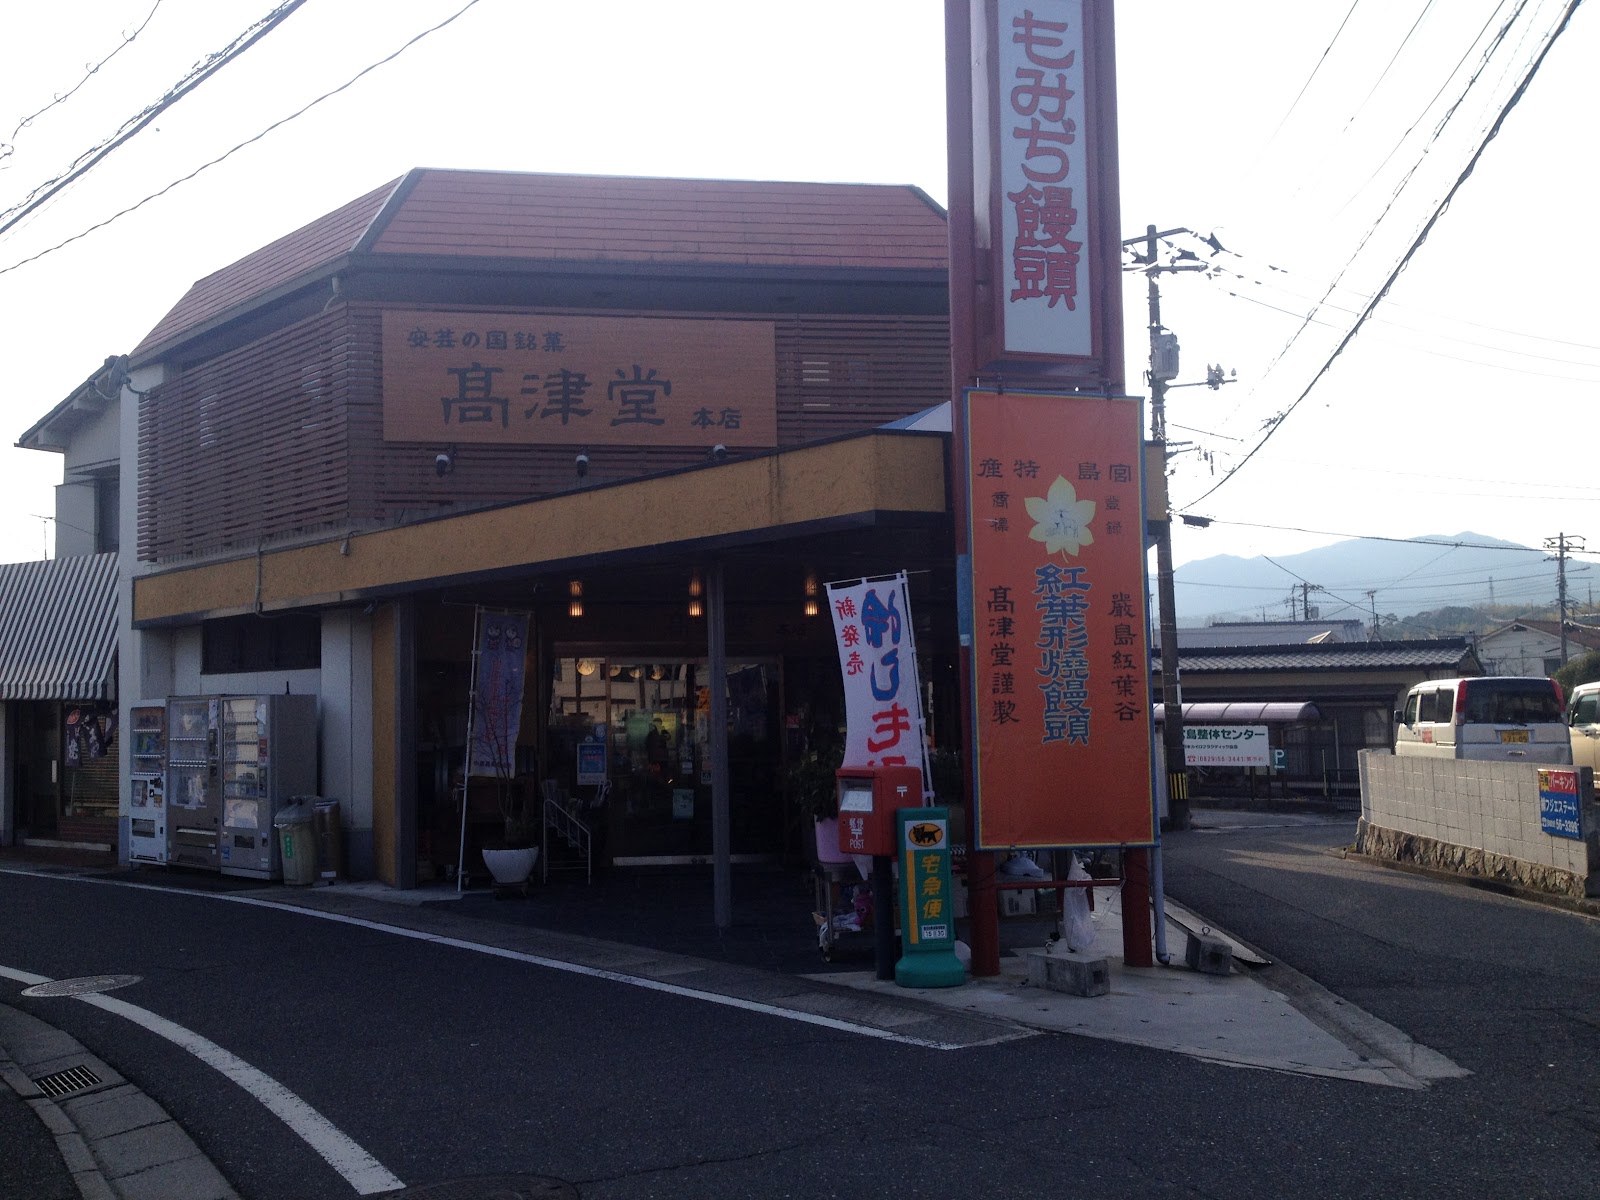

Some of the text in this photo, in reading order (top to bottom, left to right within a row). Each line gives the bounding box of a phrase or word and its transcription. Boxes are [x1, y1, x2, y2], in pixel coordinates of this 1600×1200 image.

[1007, 9, 1083, 312] もみぢ饅頭
[691, 407, 742, 431] 本店
[1183, 728, 1266, 741] 島整体センター
[849, 839, 865, 850] POST
[921, 854, 943, 920] 宅急便
